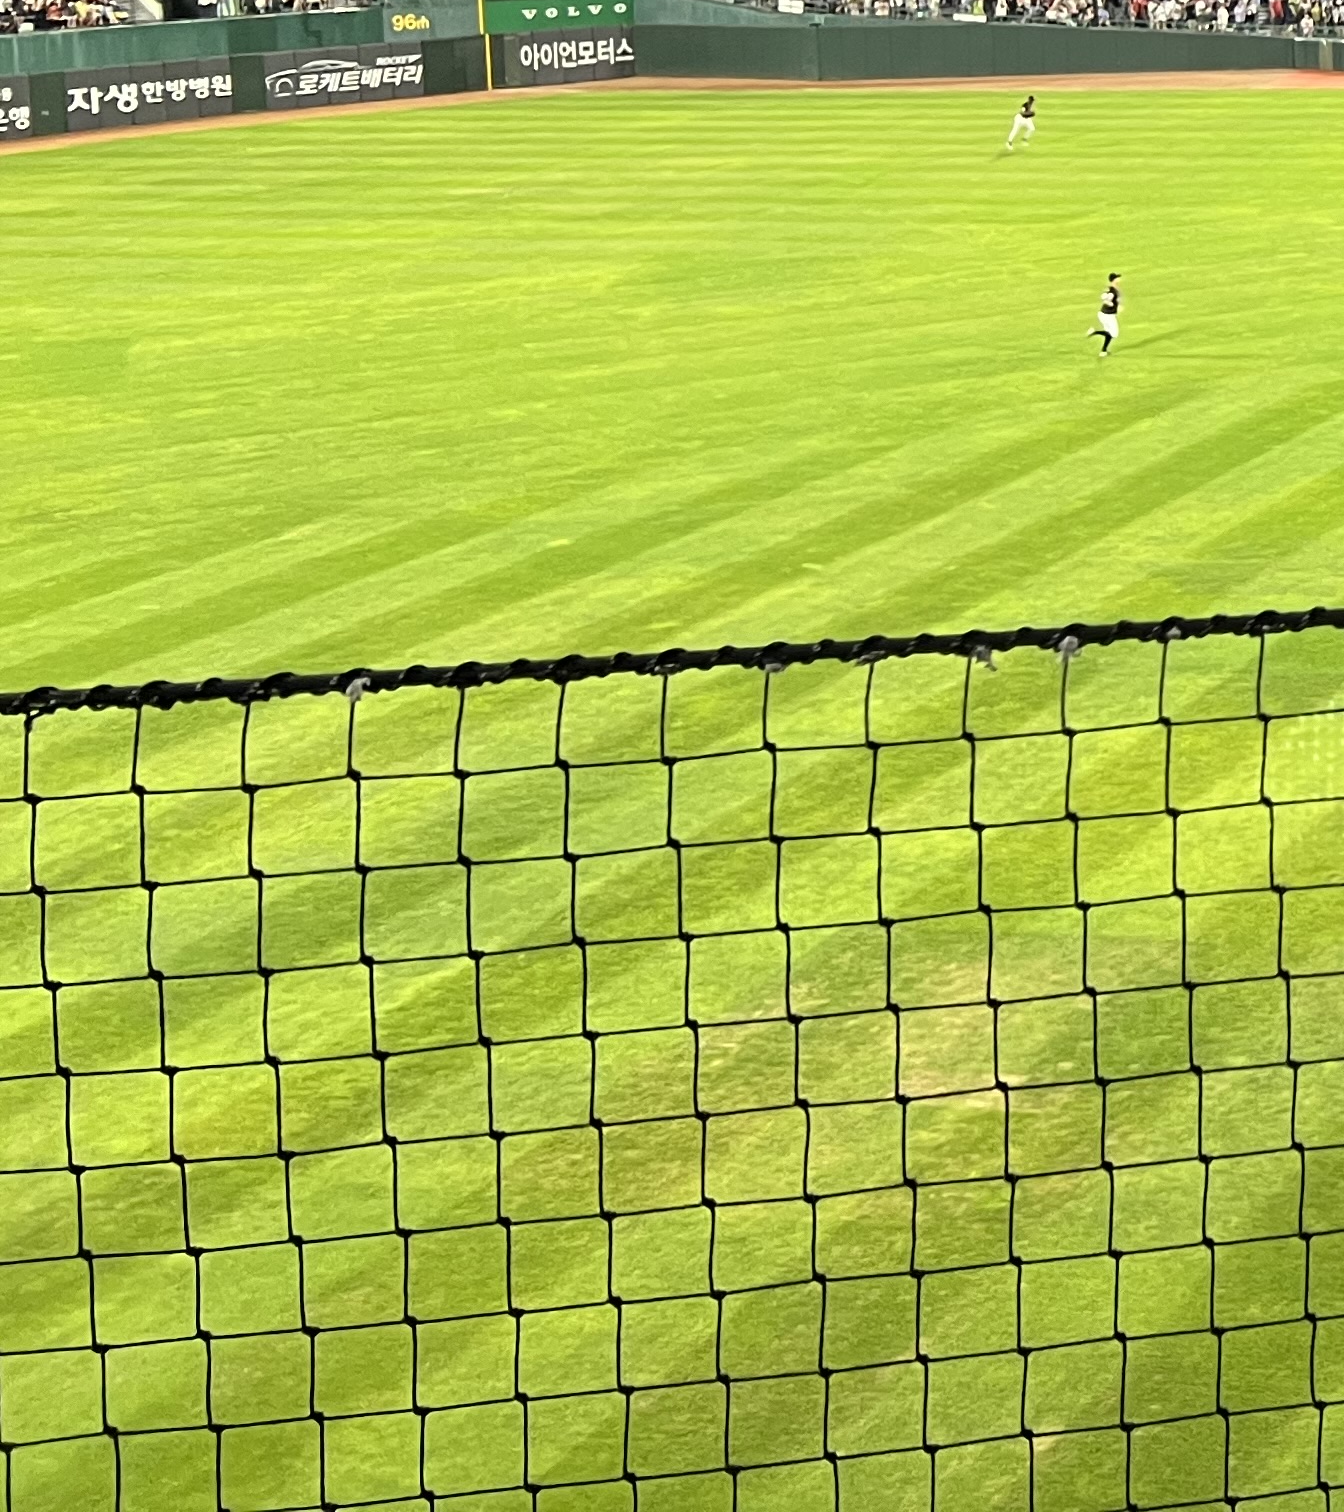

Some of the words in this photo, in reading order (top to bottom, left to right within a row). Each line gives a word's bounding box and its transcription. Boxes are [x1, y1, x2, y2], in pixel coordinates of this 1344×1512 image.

[521, 2, 628, 20] VOLVO
[520, 37, 635, 71] 아이언모터스
[295, 63, 423, 96] 로케트배터리
